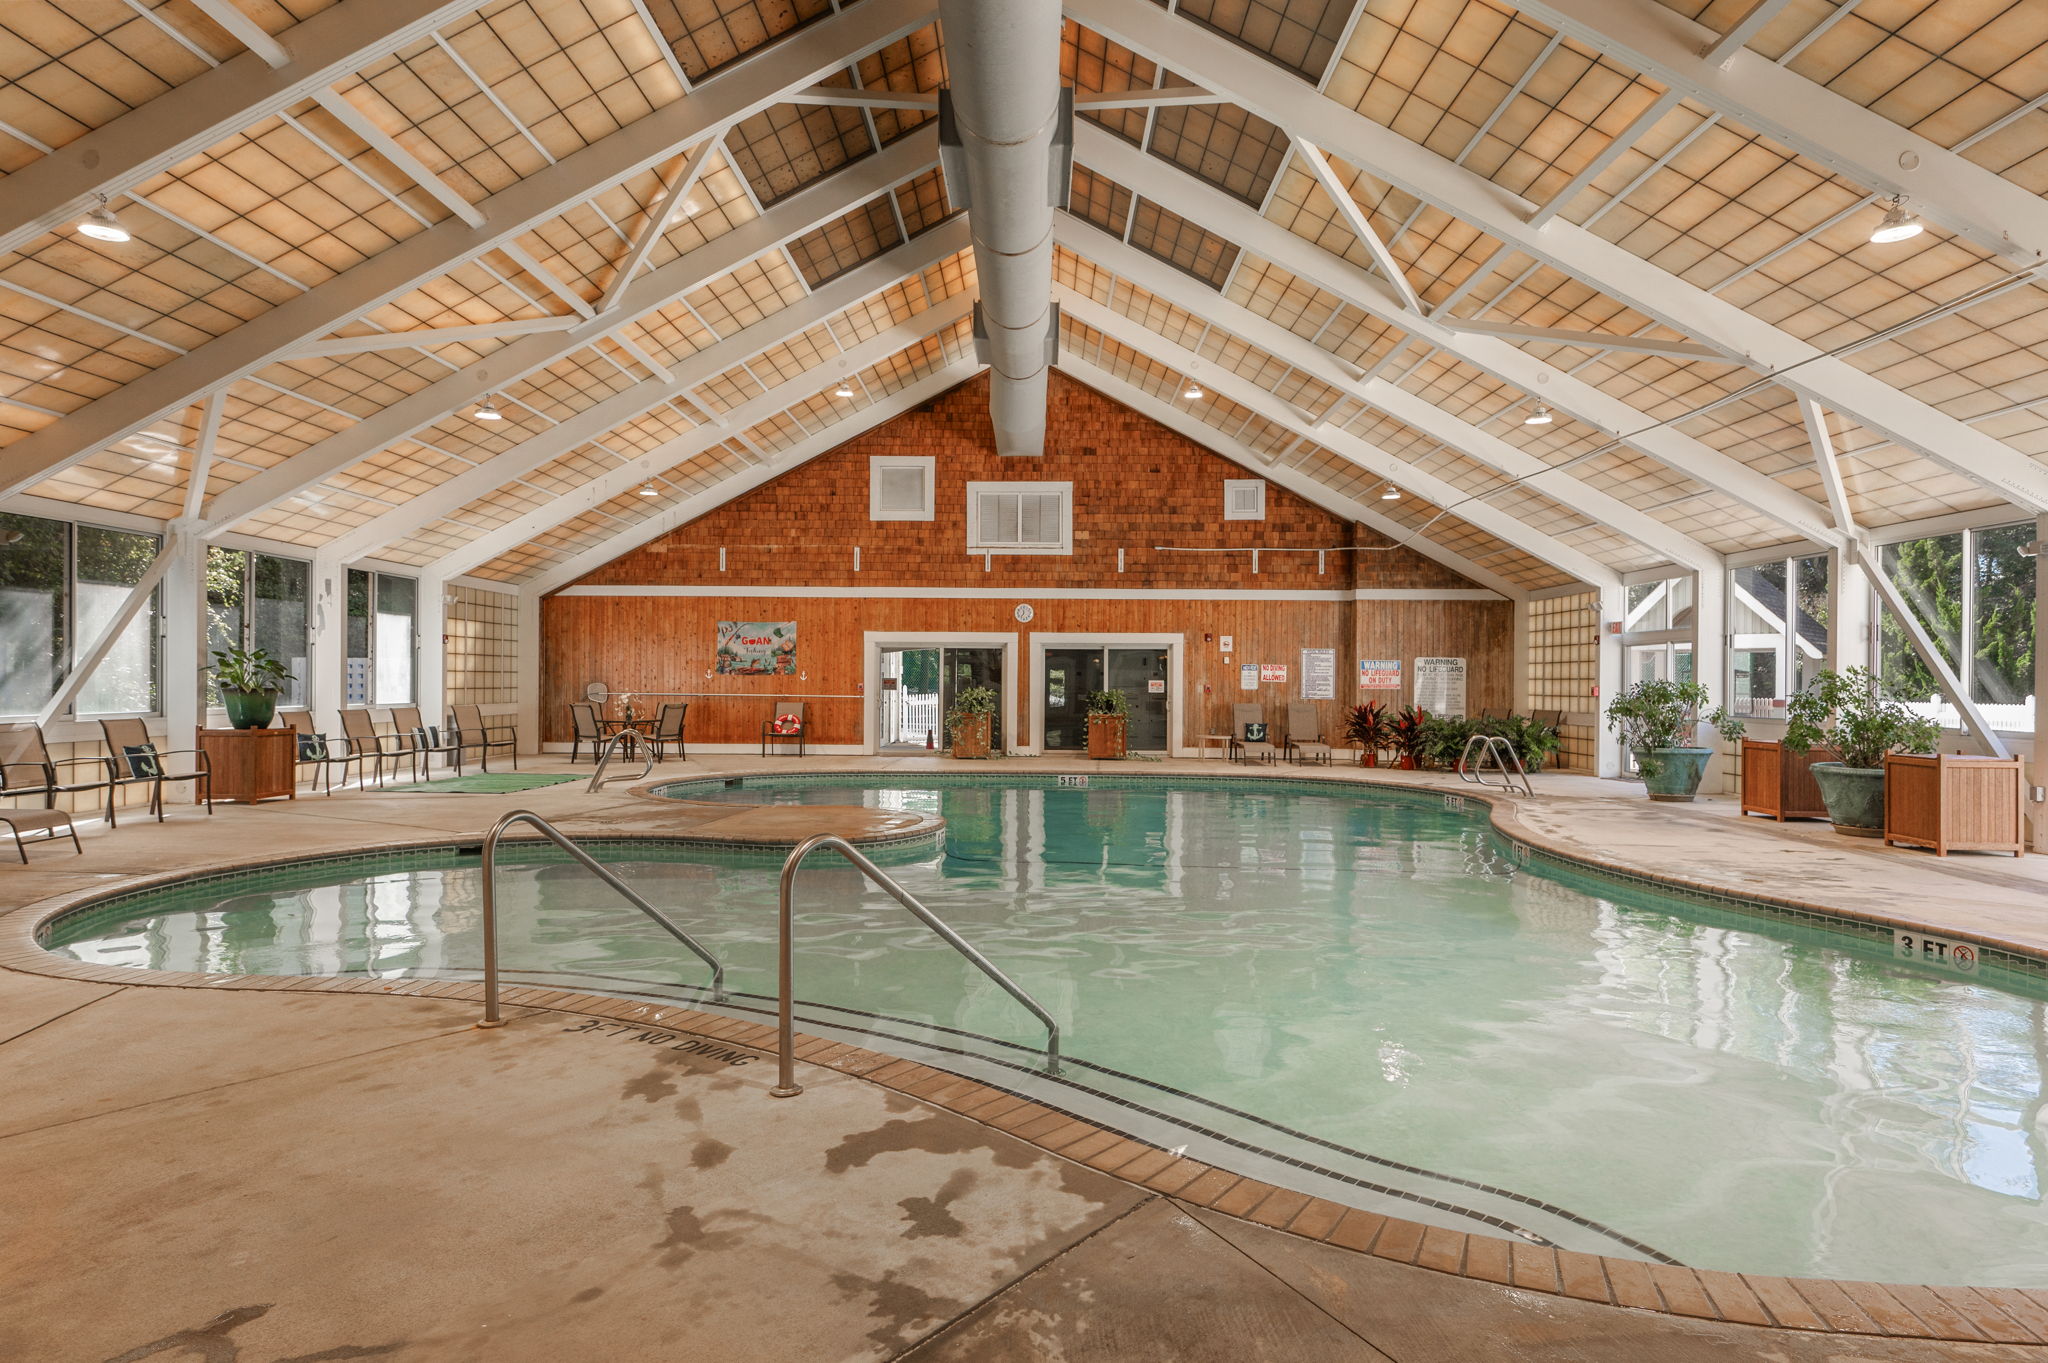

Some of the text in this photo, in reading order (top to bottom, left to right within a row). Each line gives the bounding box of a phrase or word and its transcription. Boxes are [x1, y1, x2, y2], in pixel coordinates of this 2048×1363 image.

[1363, 661, 1398, 670] WARNING
[1901, 936, 1948, 956] 3 FT
[630, 1031, 676, 1045] NO
[671, 1040, 760, 1066] DIVING
